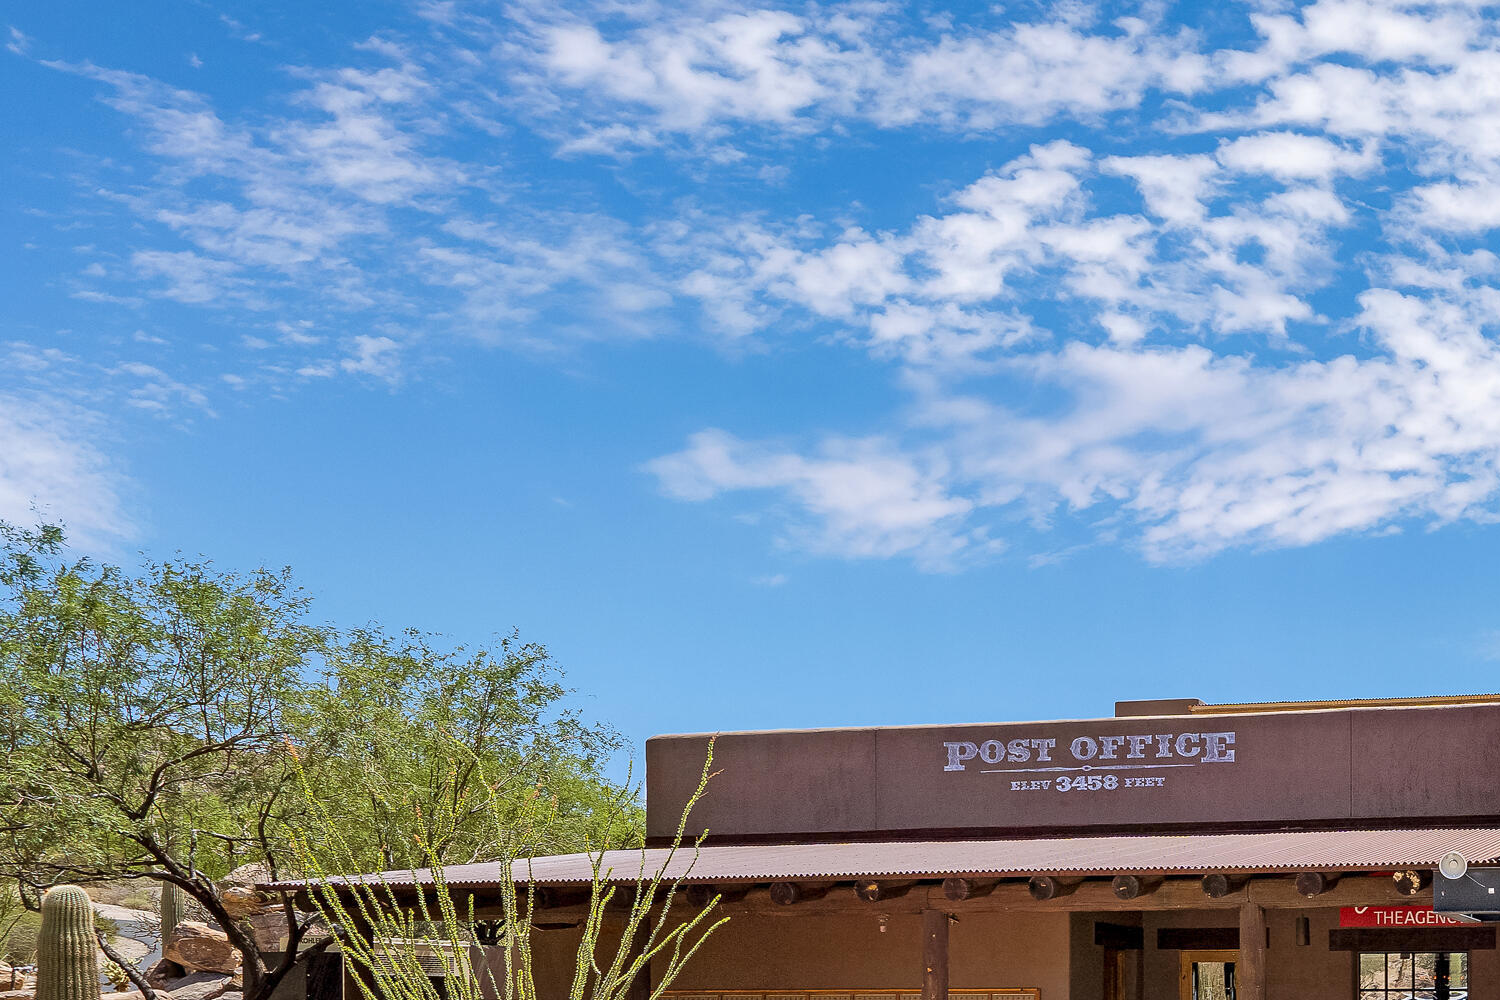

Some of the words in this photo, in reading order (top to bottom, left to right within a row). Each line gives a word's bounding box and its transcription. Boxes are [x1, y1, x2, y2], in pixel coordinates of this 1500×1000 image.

[944, 738, 1056, 772] POST
[1070, 731, 1236, 764] OFFICE
[1010, 780, 1052, 791] ELEV
[1055, 774, 1119, 792] 3458
[1124, 777, 1166, 788] FEET
[1373, 910, 1463, 925] THEAGEN
